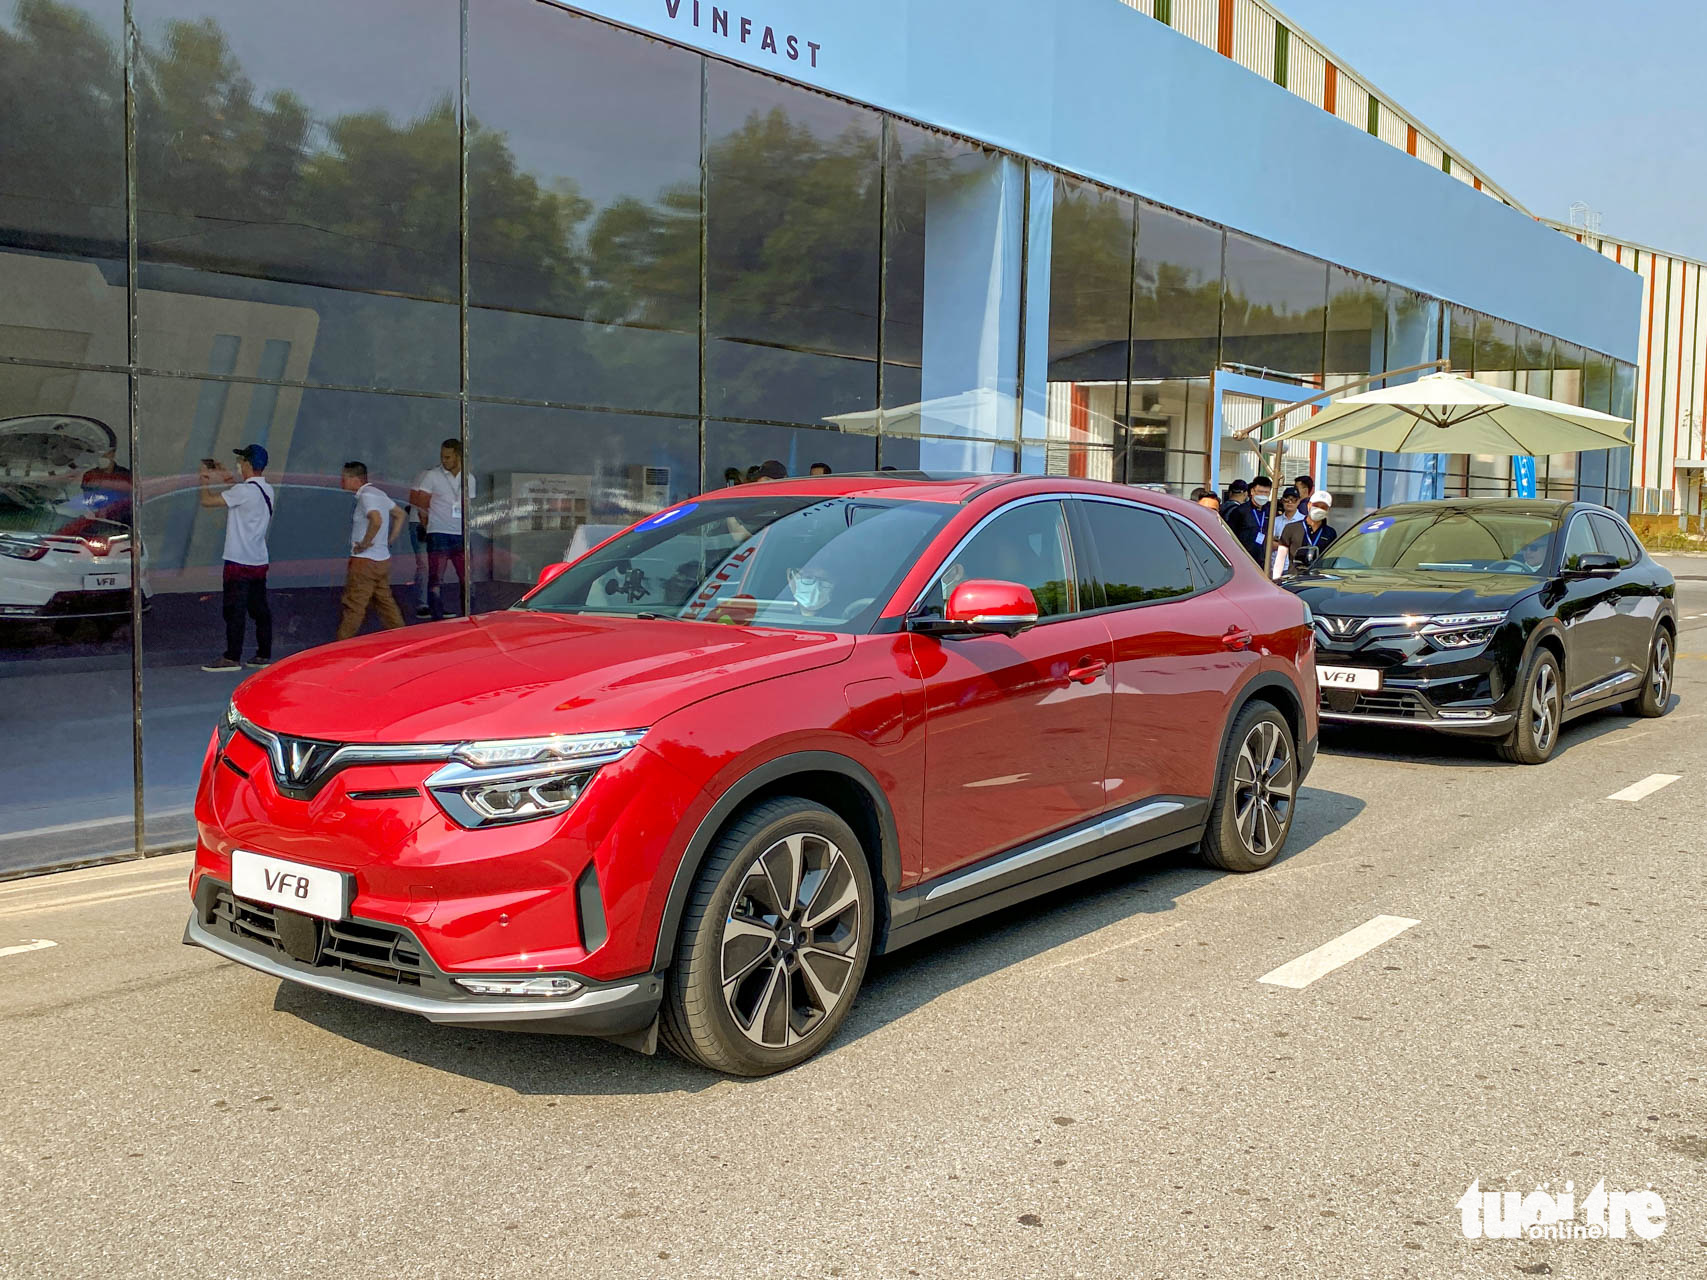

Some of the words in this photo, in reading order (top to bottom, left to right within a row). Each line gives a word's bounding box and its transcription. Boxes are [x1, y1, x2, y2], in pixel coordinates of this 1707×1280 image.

[665, 0, 820, 68] VINFAST
[652, 509, 681, 524] 1
[1367, 520, 1385, 530] 2
[1323, 671, 1356, 683] VF8
[264, 868, 310, 899] VF8
